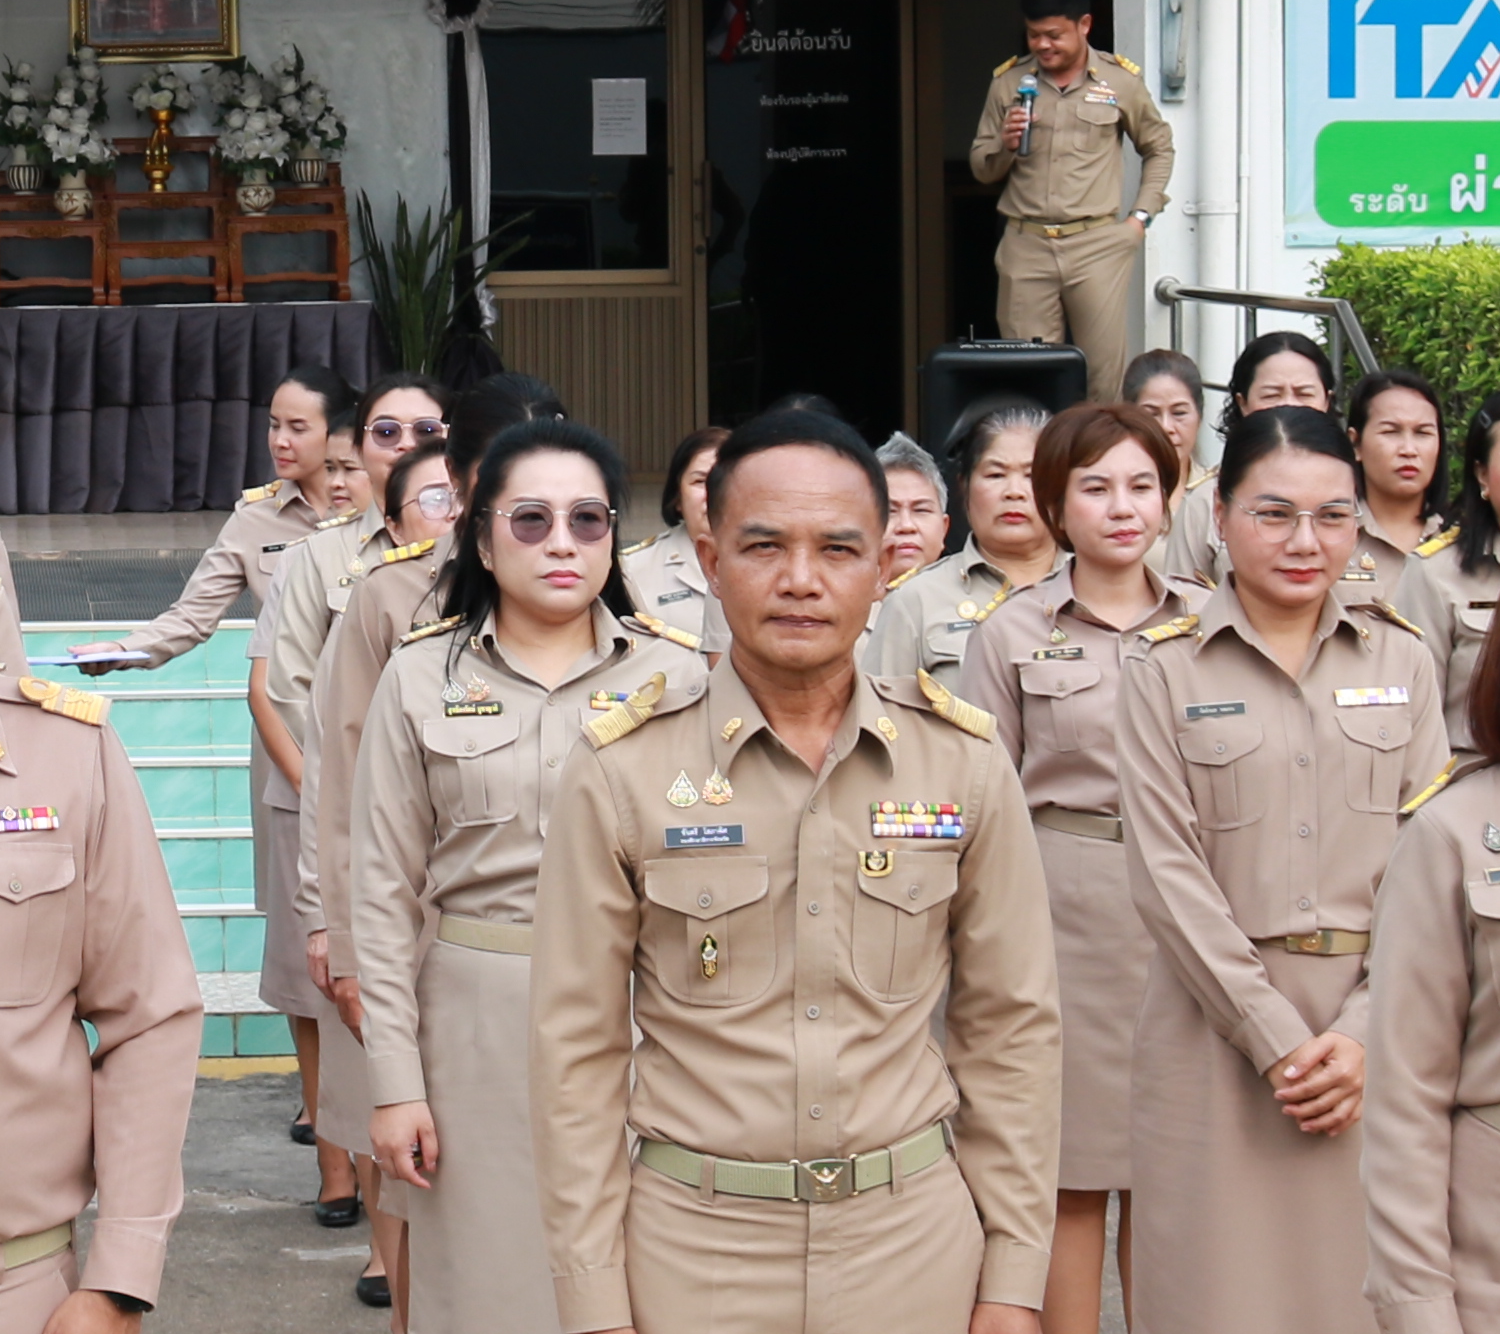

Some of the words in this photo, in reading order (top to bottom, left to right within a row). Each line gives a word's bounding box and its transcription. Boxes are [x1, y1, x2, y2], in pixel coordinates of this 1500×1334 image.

[750, 28, 851, 53] ยินดีต้อนรับ
[1348, 183, 1428, 214] ระดับ
